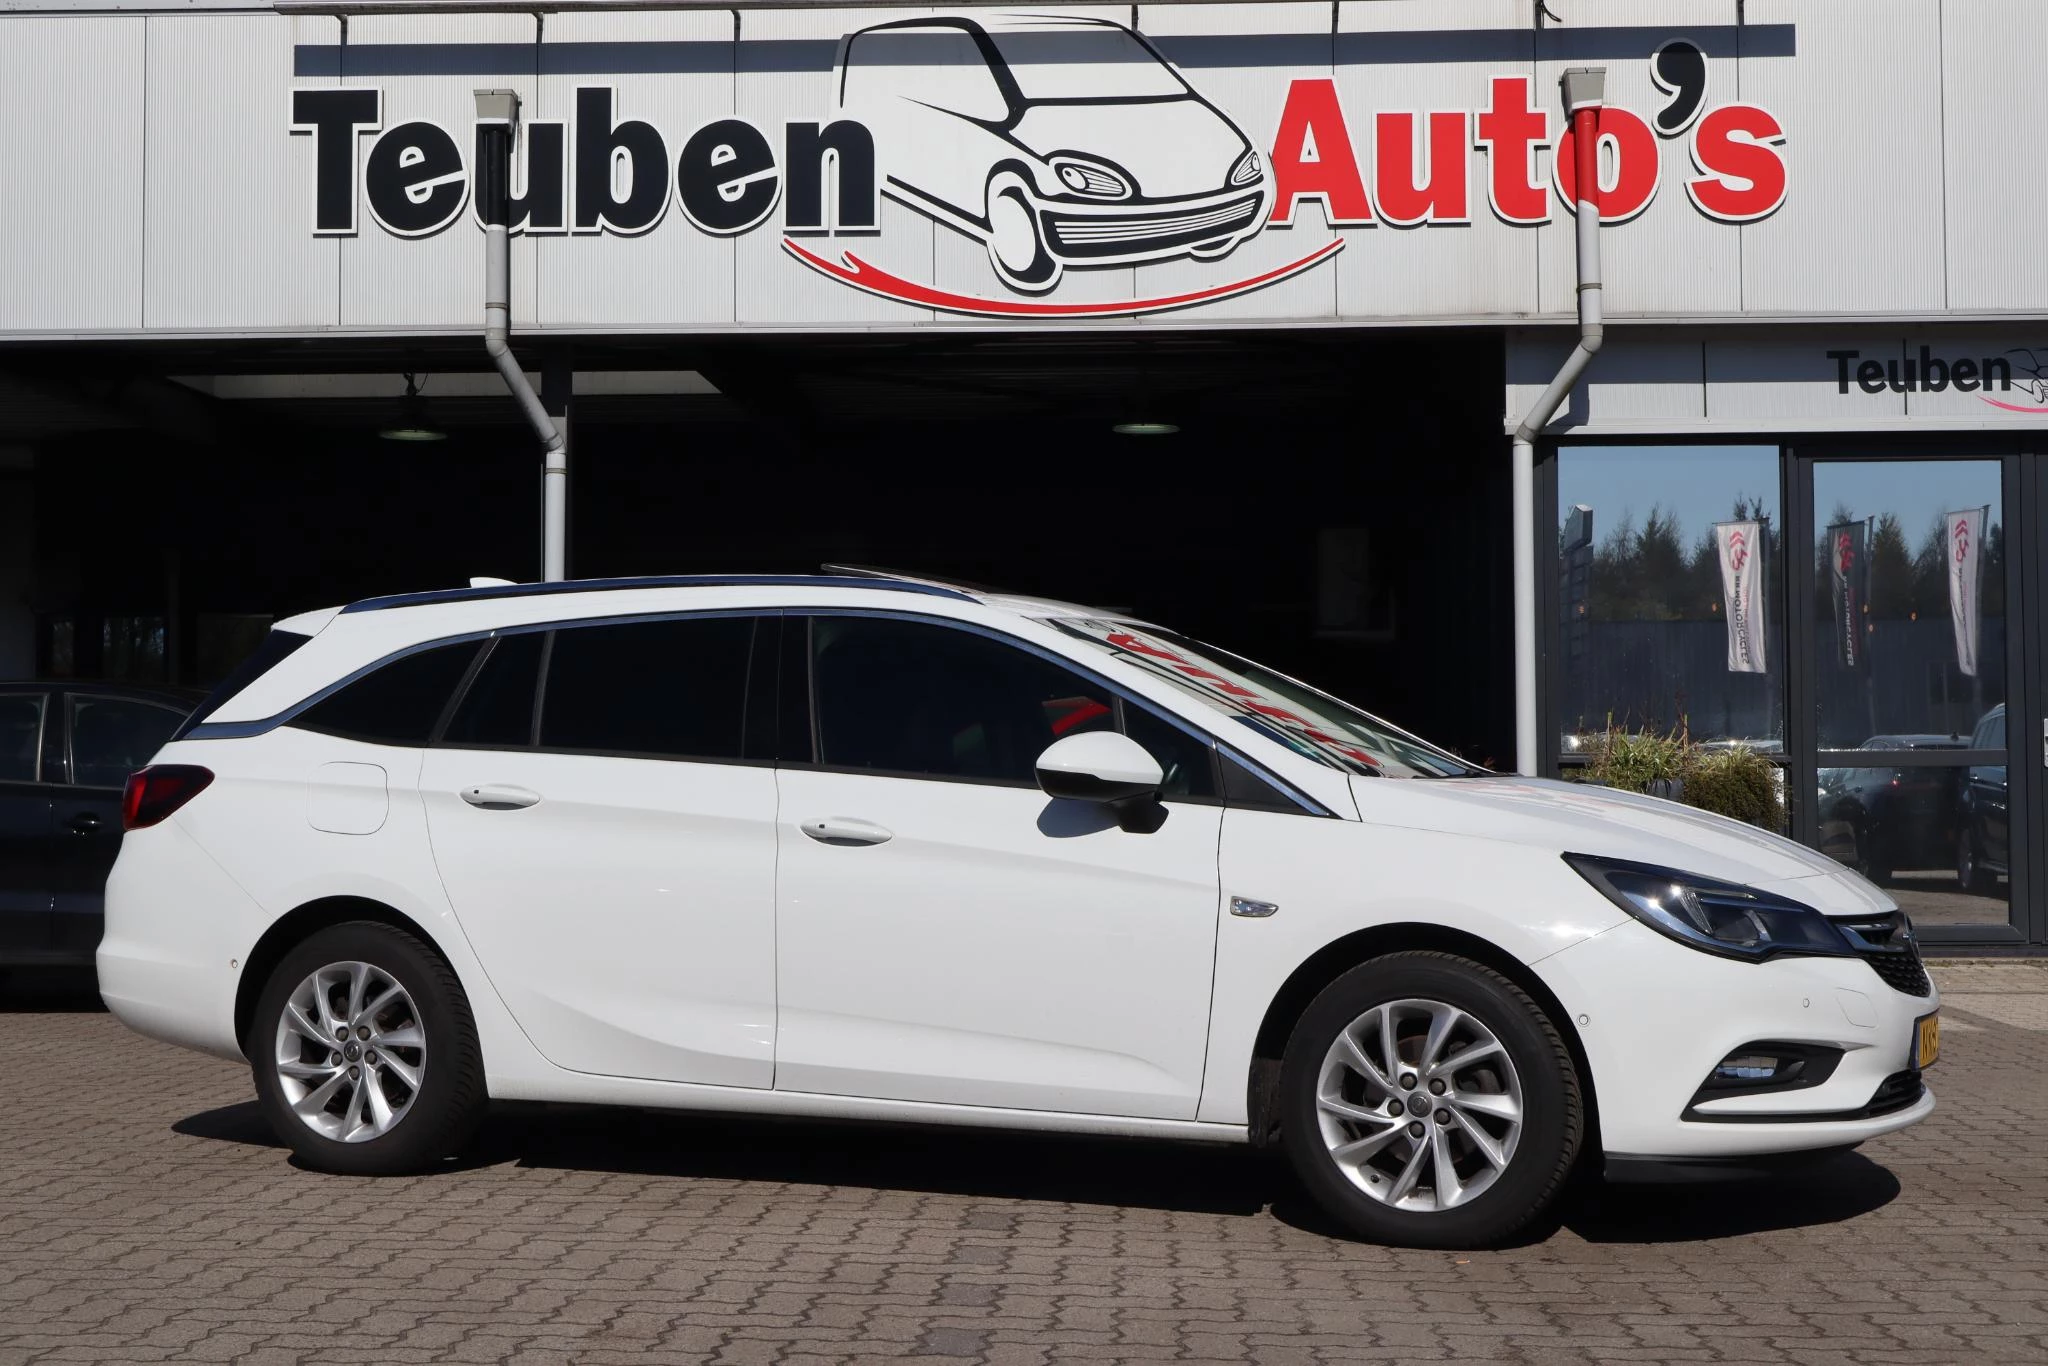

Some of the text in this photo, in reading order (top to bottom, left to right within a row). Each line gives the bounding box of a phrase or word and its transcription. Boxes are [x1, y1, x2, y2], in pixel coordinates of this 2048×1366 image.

[290, 40, 1788, 236] Teuben Auto's
[1826, 344, 2012, 394] Teuben
